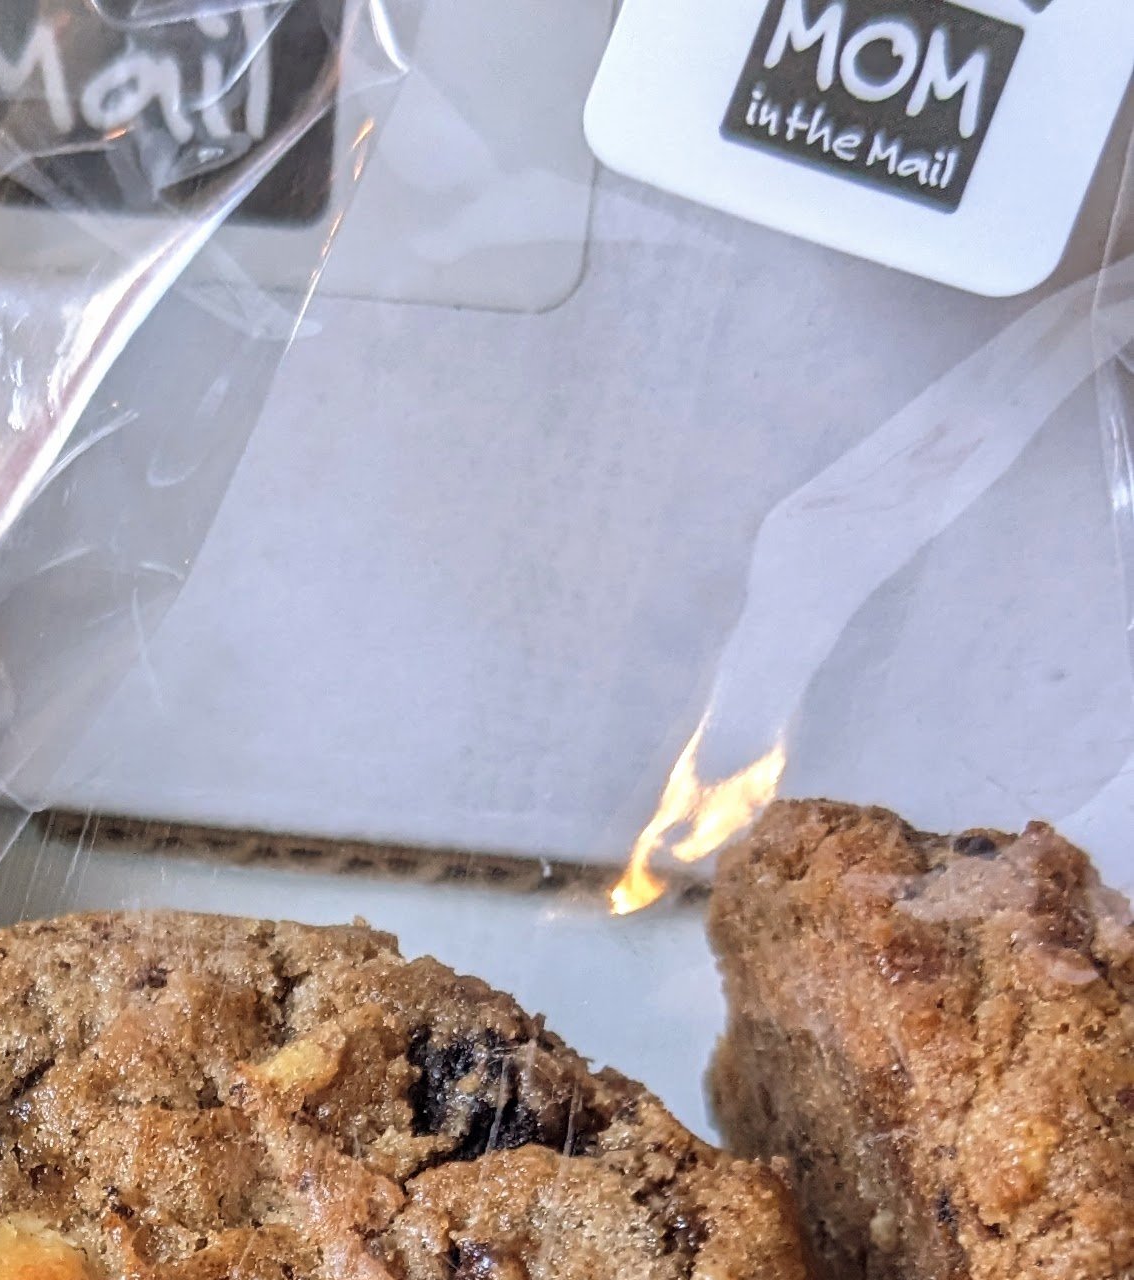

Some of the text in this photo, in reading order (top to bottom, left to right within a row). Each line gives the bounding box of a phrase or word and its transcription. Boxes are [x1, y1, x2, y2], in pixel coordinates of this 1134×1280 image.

[763, 0, 987, 140] MOM
[785, 104, 863, 162] the
[866, 133, 958, 189] Mail
